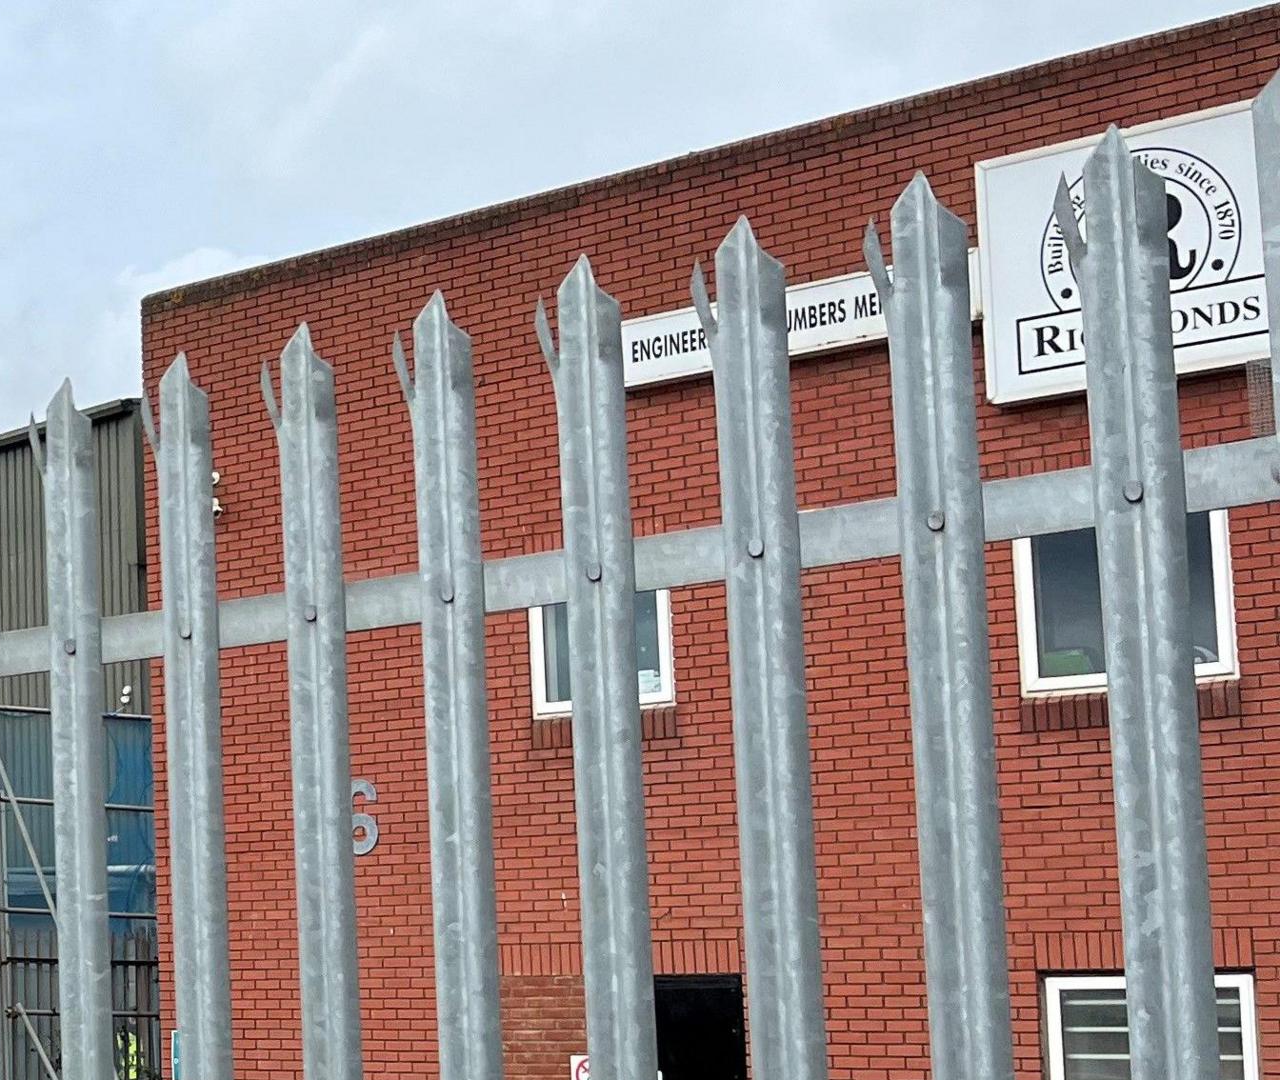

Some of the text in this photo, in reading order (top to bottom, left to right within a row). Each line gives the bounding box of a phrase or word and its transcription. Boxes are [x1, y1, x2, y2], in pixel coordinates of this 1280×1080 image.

[1175, 162, 1217, 196] since
[1213, 201, 1235, 240] 1870
[631, 328, 708, 363] ENGINEER
